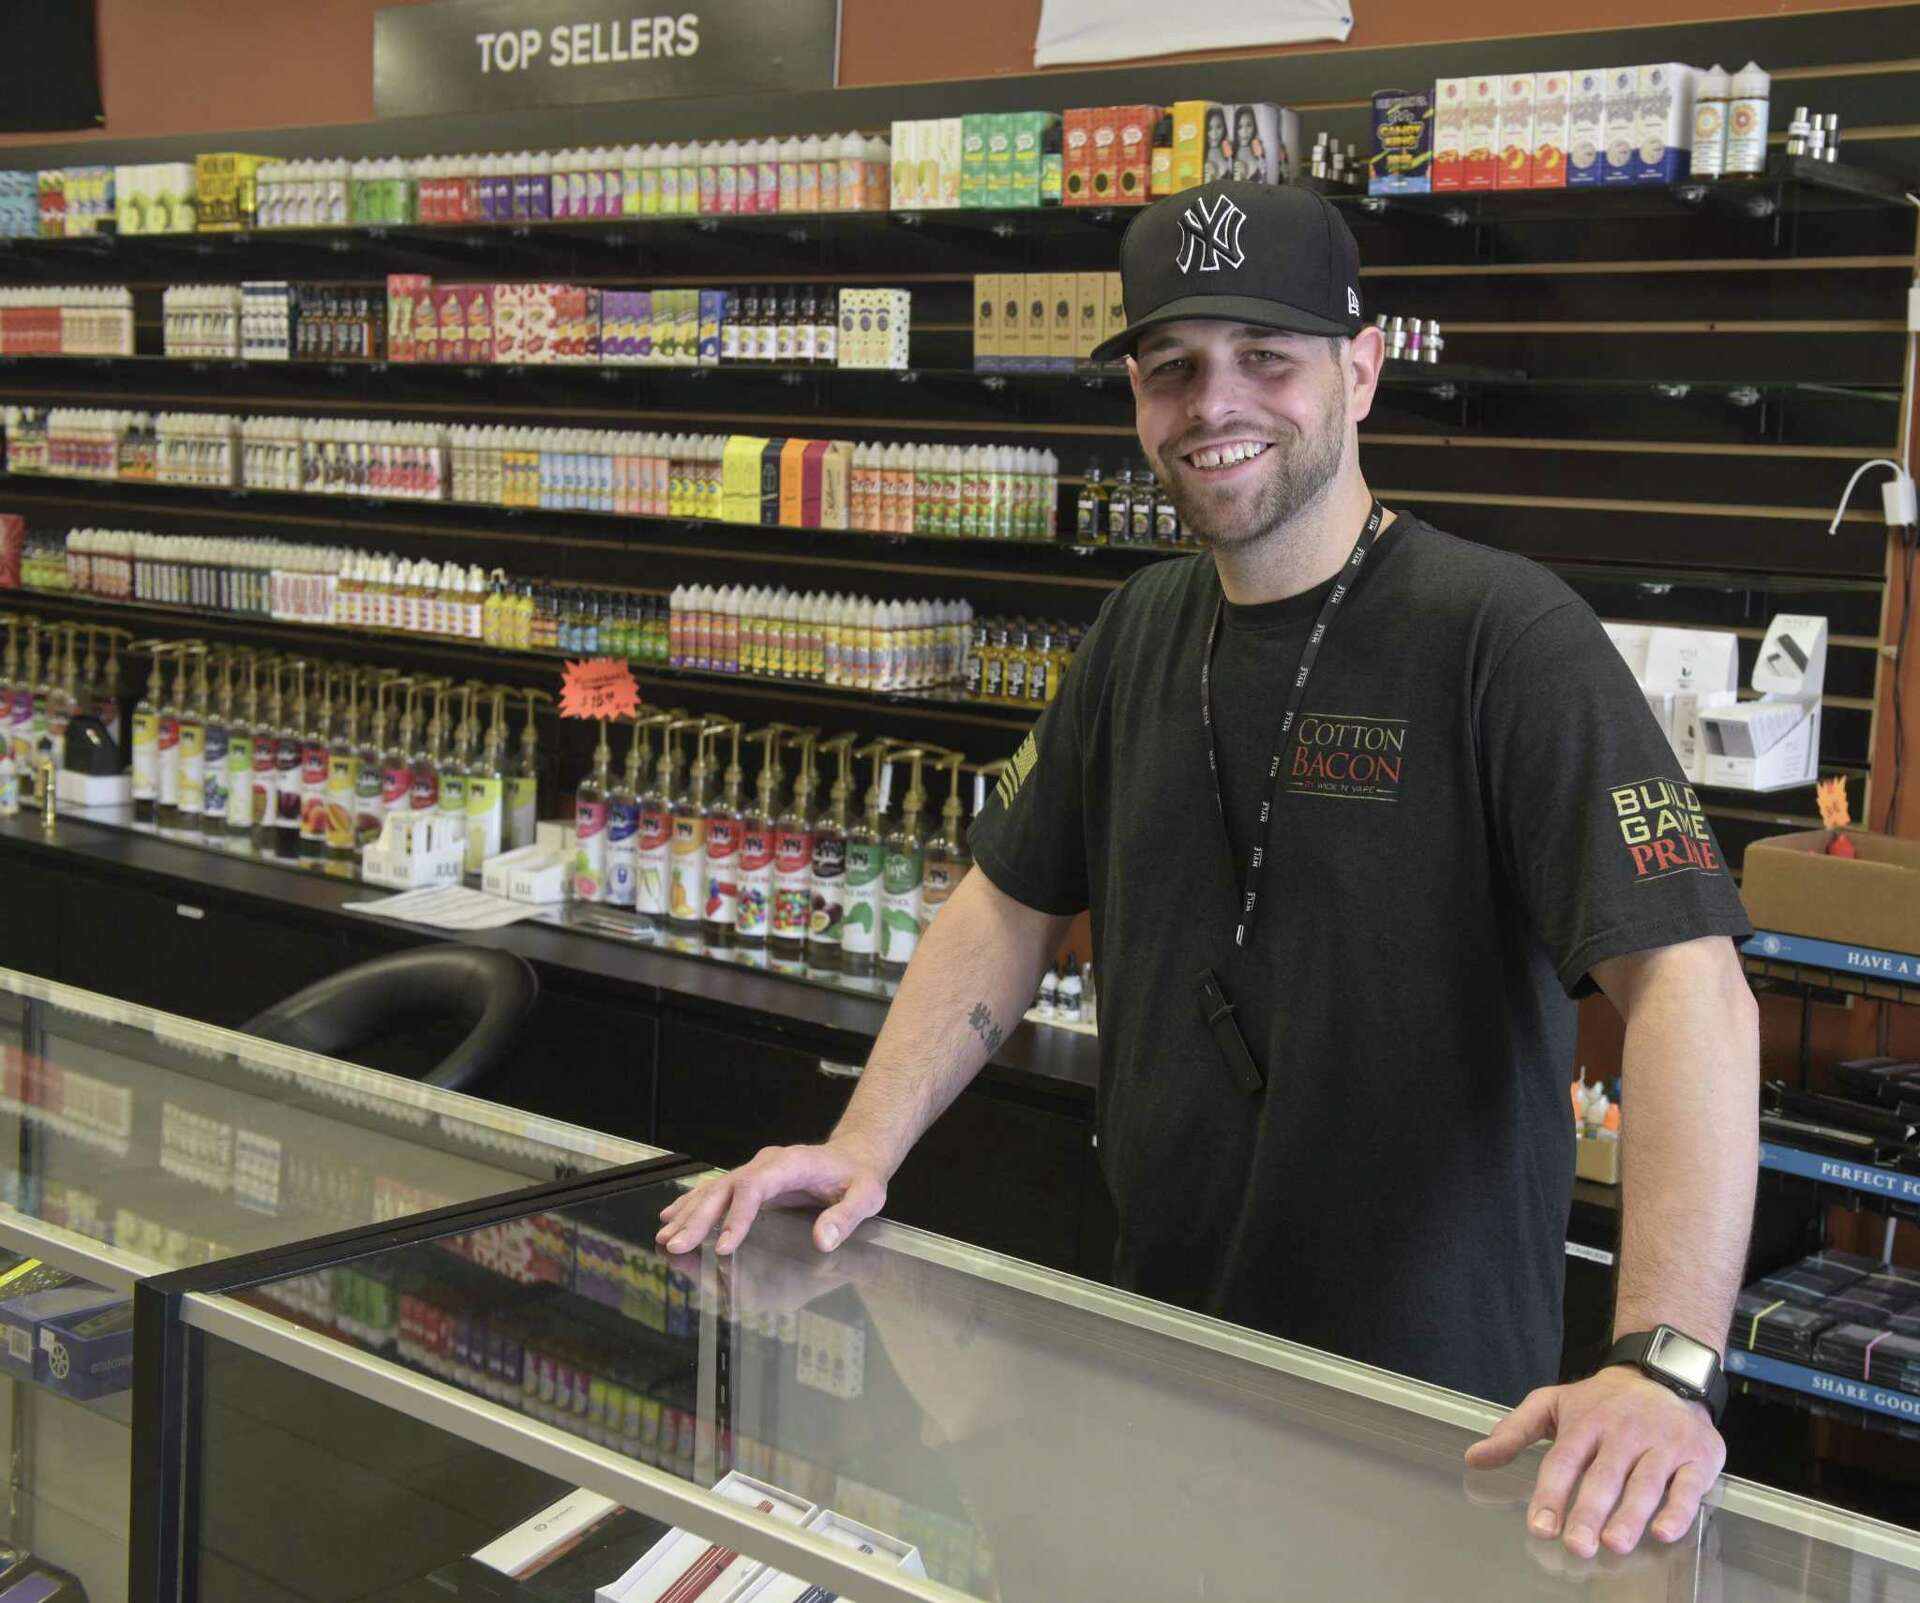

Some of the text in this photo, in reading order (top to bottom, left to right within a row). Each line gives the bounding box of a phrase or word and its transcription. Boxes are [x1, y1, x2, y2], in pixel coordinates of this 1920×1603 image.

[476, 13, 699, 73] TOP SELLERS
[1298, 718, 1406, 752] COTTON
[1291, 746, 1403, 784] BACON
[1611, 782, 1701, 816] BUILD
[1620, 809, 1710, 844] GAME
[1847, 952, 1893, 971] HAVE
[1897, 960, 1908, 974] A
[1821, 1162, 1896, 1190] PERFECT
[1812, 1376, 1868, 1401] SHARE
